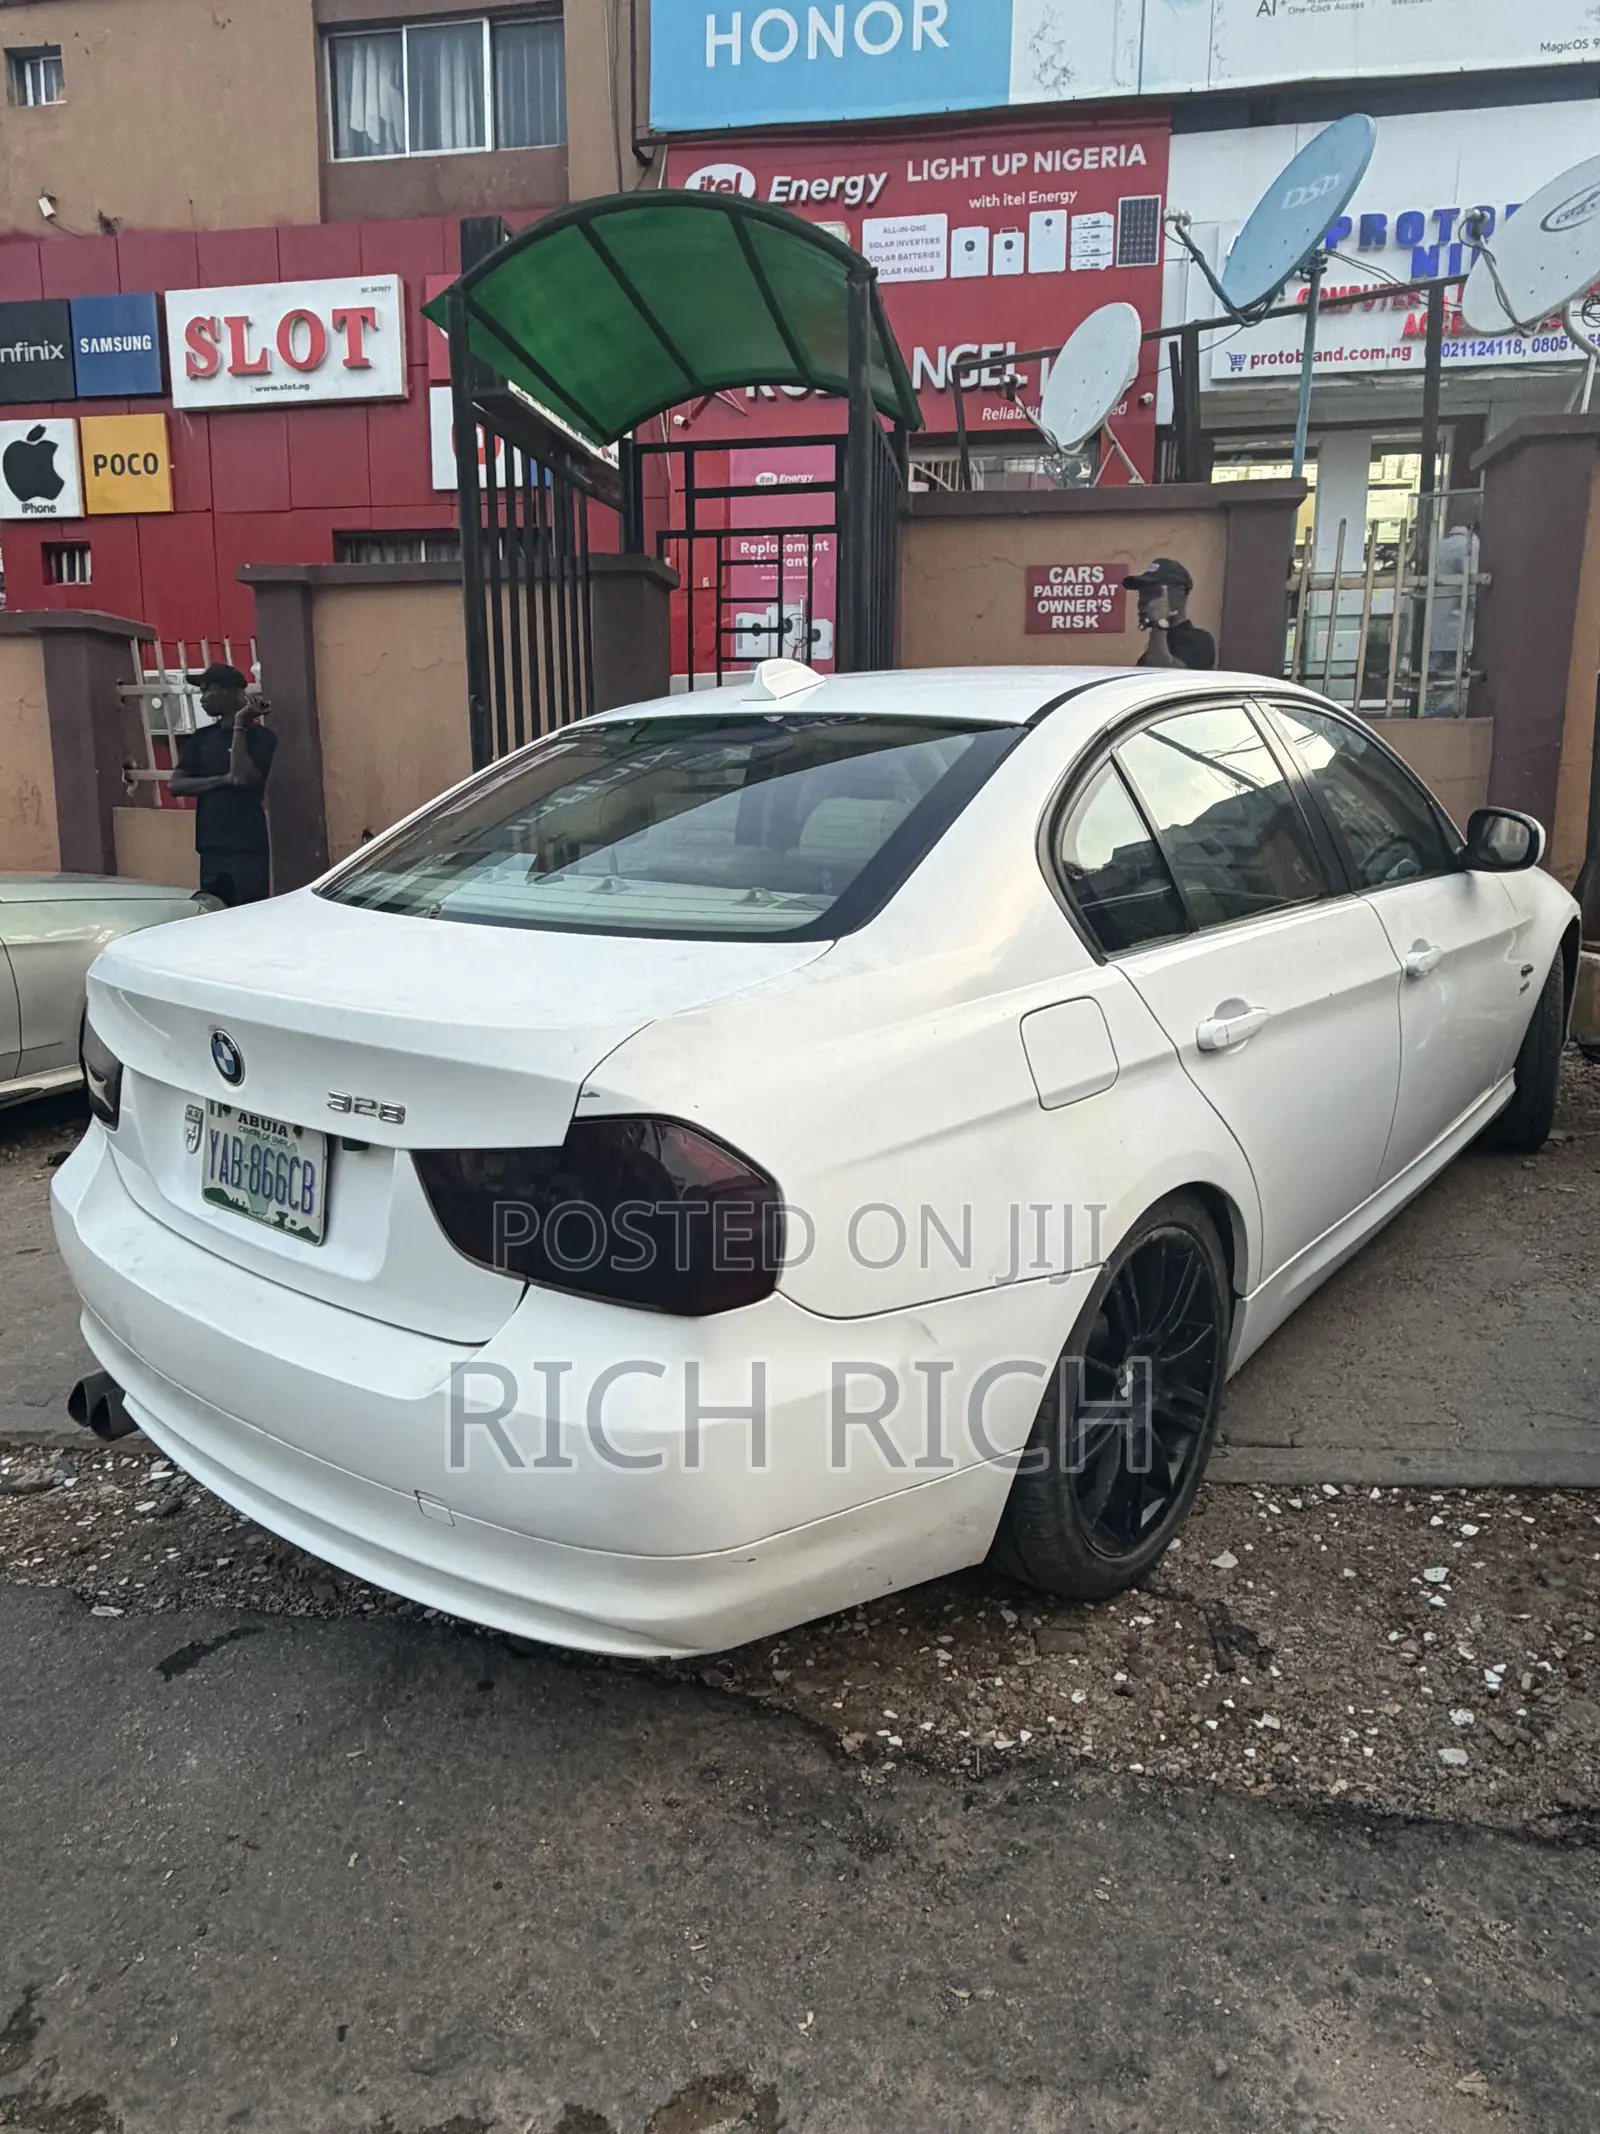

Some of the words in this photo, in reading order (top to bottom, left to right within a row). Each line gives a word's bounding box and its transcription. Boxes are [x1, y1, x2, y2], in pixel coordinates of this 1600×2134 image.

[706, 0, 950, 68] HONOR
[1540, 38, 1589, 54] MagicOS
[907, 155, 986, 182] LIGHT
[991, 153, 1028, 177] UP
[1033, 143, 1147, 174] NIGERIA
[768, 171, 889, 206] Energy
[968, 194, 1000, 209] with
[1003, 191, 1026, 206] itel
[1028, 189, 1078, 205] Energy
[1325, 203, 1523, 251] PROTO
[879, 267, 902, 276] OLAR
[903, 264, 935, 274] PANELS
[0, 340, 65, 363] nfinix
[80, 334, 152, 354] SAMSUNG
[185, 307, 380, 380] SLOT
[1251, 346, 1412, 369] protoband.com.ng
[93, 452, 159, 477] POCO
[779, 473, 814, 484] Energy
[21, 503, 57, 514] iPhone
[1048, 566, 1104, 584] CARS
[1033, 584, 1094, 598] PARKED
[1098, 584, 1118, 596] AT
[1037, 599, 1112, 614] OWNER'S
[1051, 615, 1099, 629] RISK
[326, 1089, 406, 1125] 328
[238, 1112, 289, 1138] ABUJA
[210, 1128, 314, 1215] YAB-866CB
